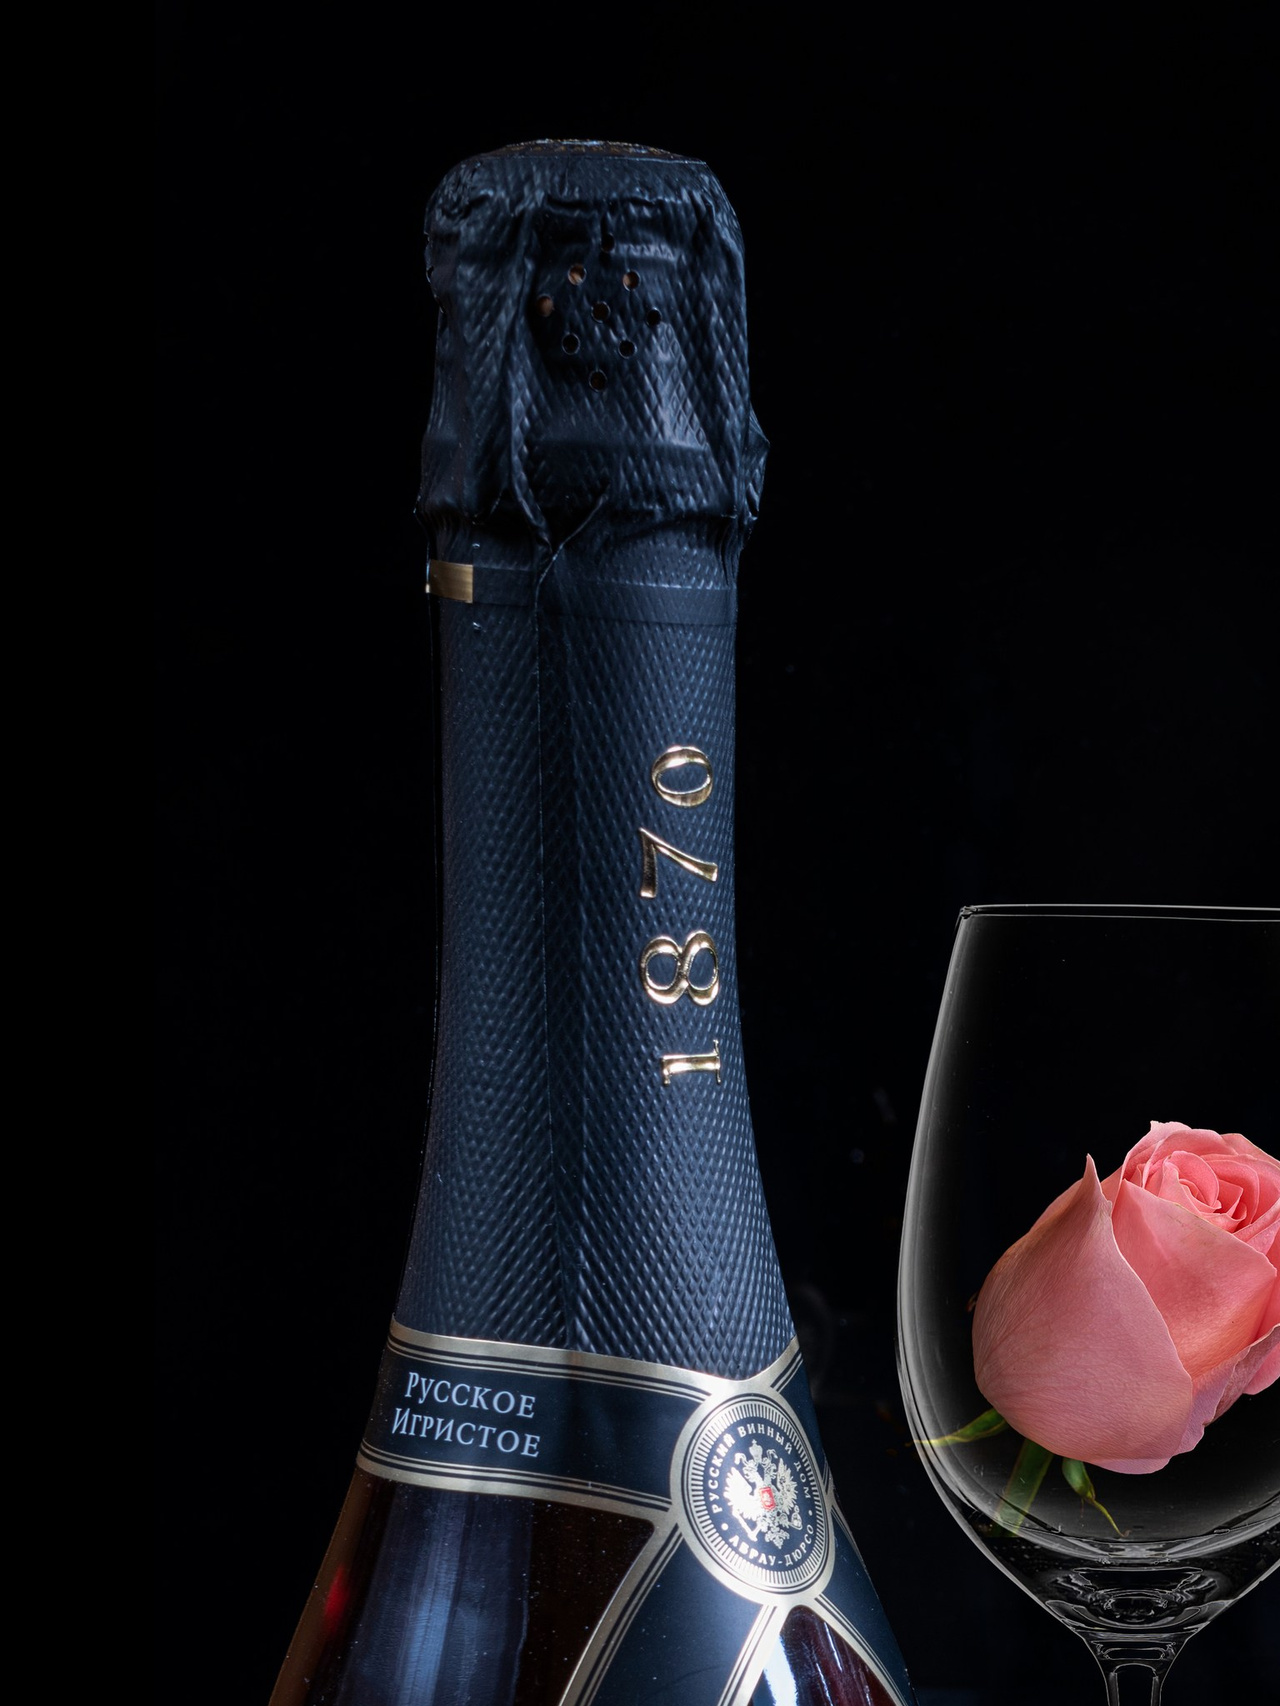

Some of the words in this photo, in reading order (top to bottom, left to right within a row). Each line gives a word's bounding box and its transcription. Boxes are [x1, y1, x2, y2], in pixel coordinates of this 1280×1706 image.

[638, 744, 721, 1086] 1870
[404, 1371, 536, 1419] РУССКОЕ
[391, 1407, 541, 1458] ИГРИСТОЕ
[707, 1433, 736, 1514] РУССКИЙ
[737, 1423, 794, 1455] ВИННЫЙ
[793, 1461, 811, 1499] ДОМ
[728, 1524, 815, 1567] АБРАУ-ДЮРСО
